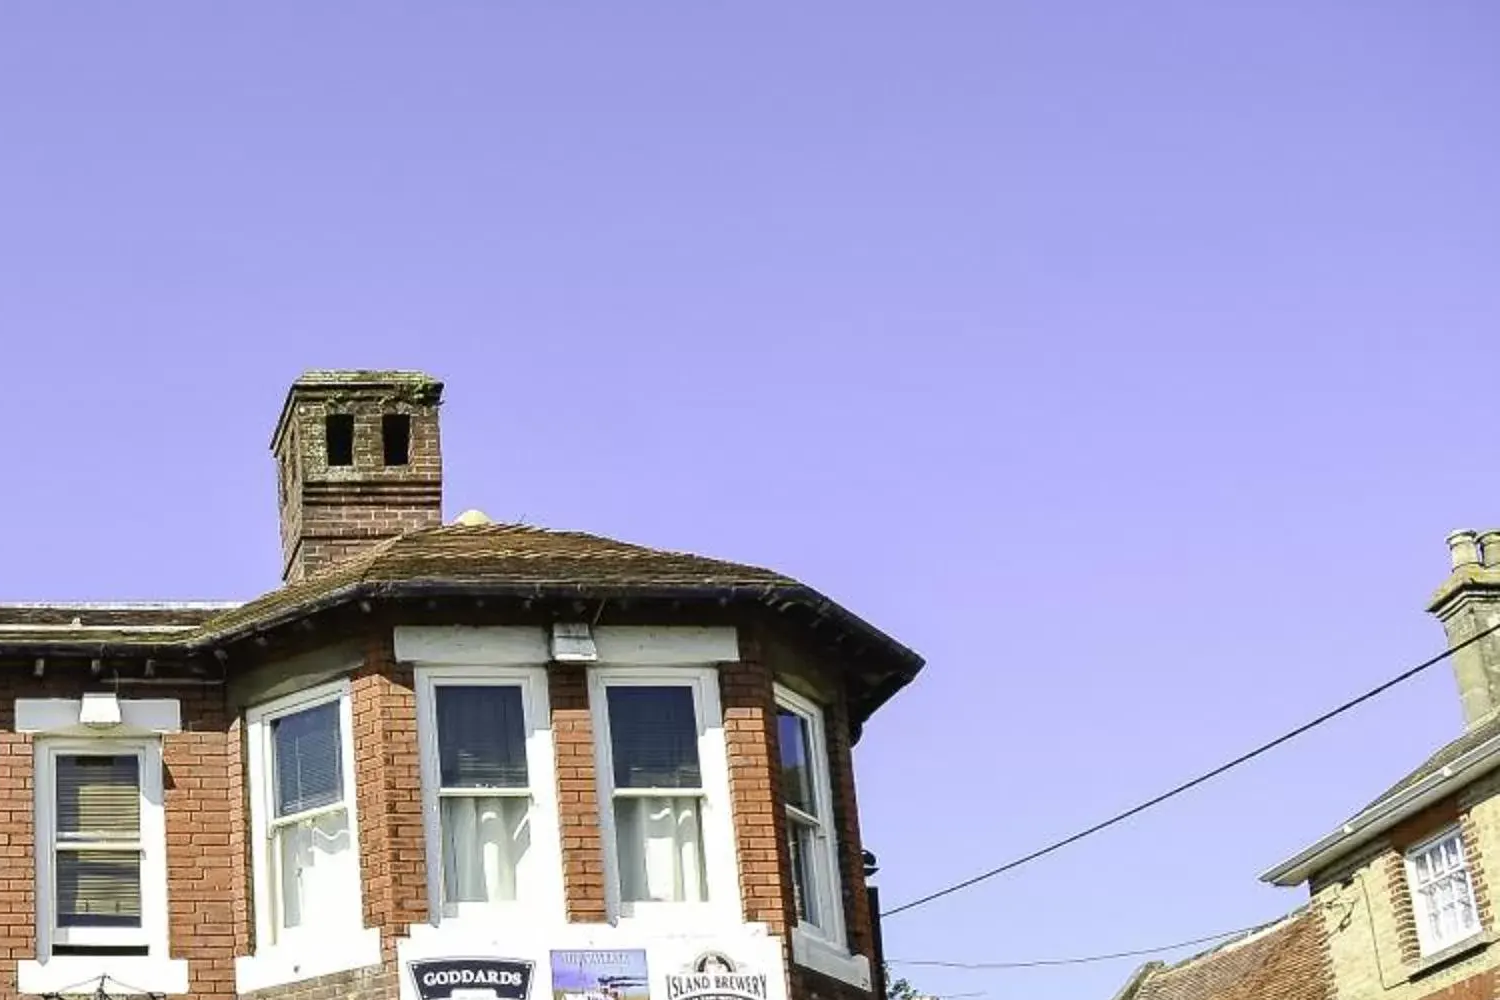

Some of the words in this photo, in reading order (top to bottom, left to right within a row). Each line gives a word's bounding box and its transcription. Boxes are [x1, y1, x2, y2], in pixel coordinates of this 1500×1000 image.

[422, 969, 523, 987] GODDARDS
[665, 974, 711, 1000] ISLAND
[714, 973, 767, 1000] BREWERY
